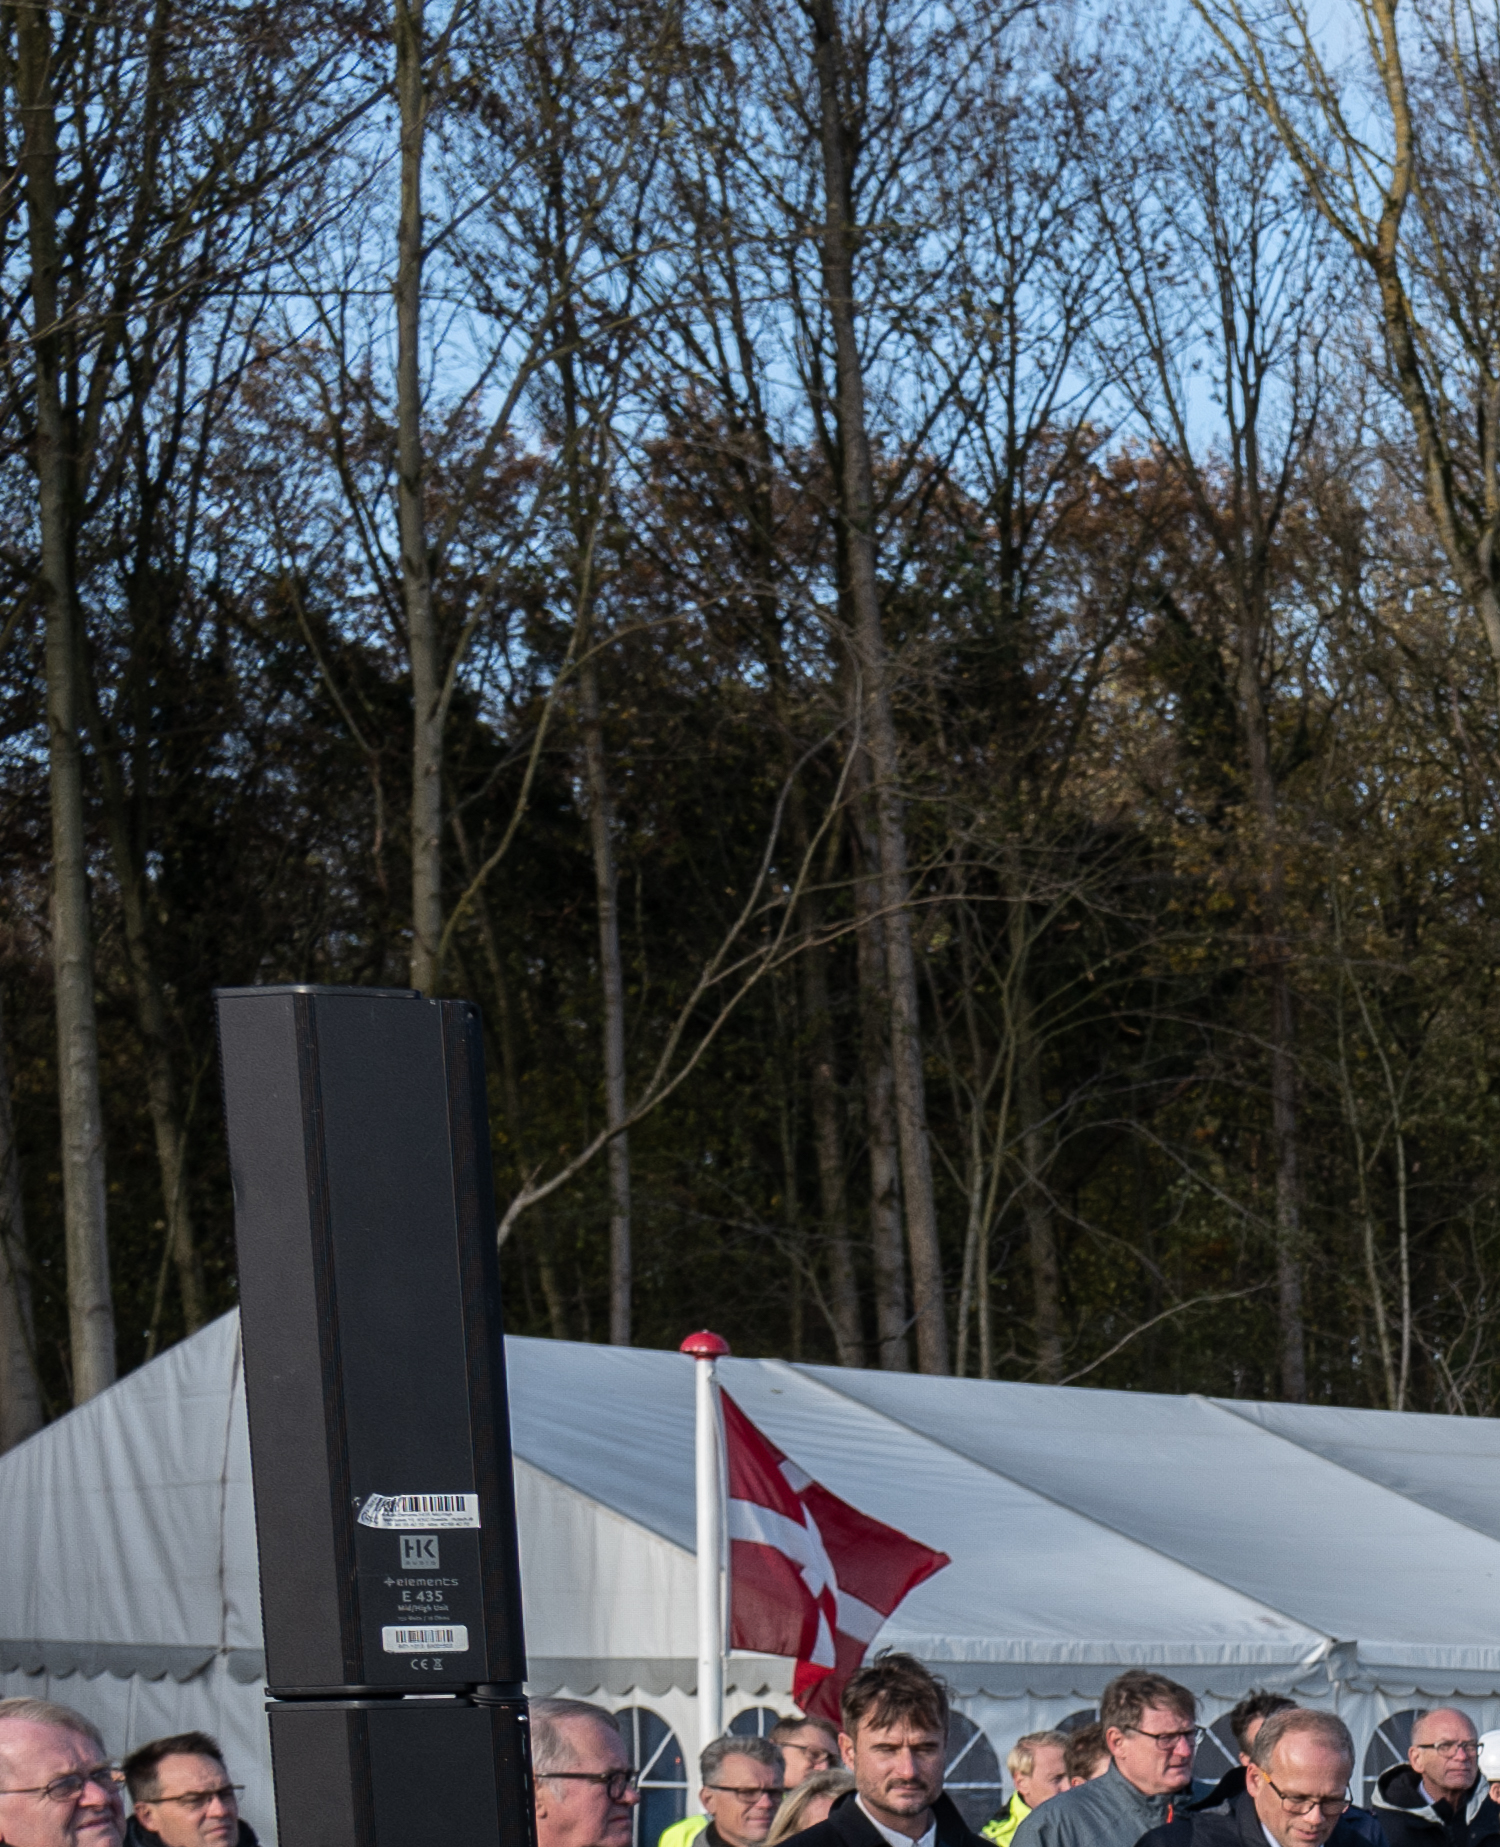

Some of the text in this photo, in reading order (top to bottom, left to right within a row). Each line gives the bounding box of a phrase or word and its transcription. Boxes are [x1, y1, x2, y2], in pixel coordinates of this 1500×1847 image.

[404, 1539, 436, 1558] HK
[396, 1578, 459, 1587] elements
[402, 1590, 443, 1602] E 435
